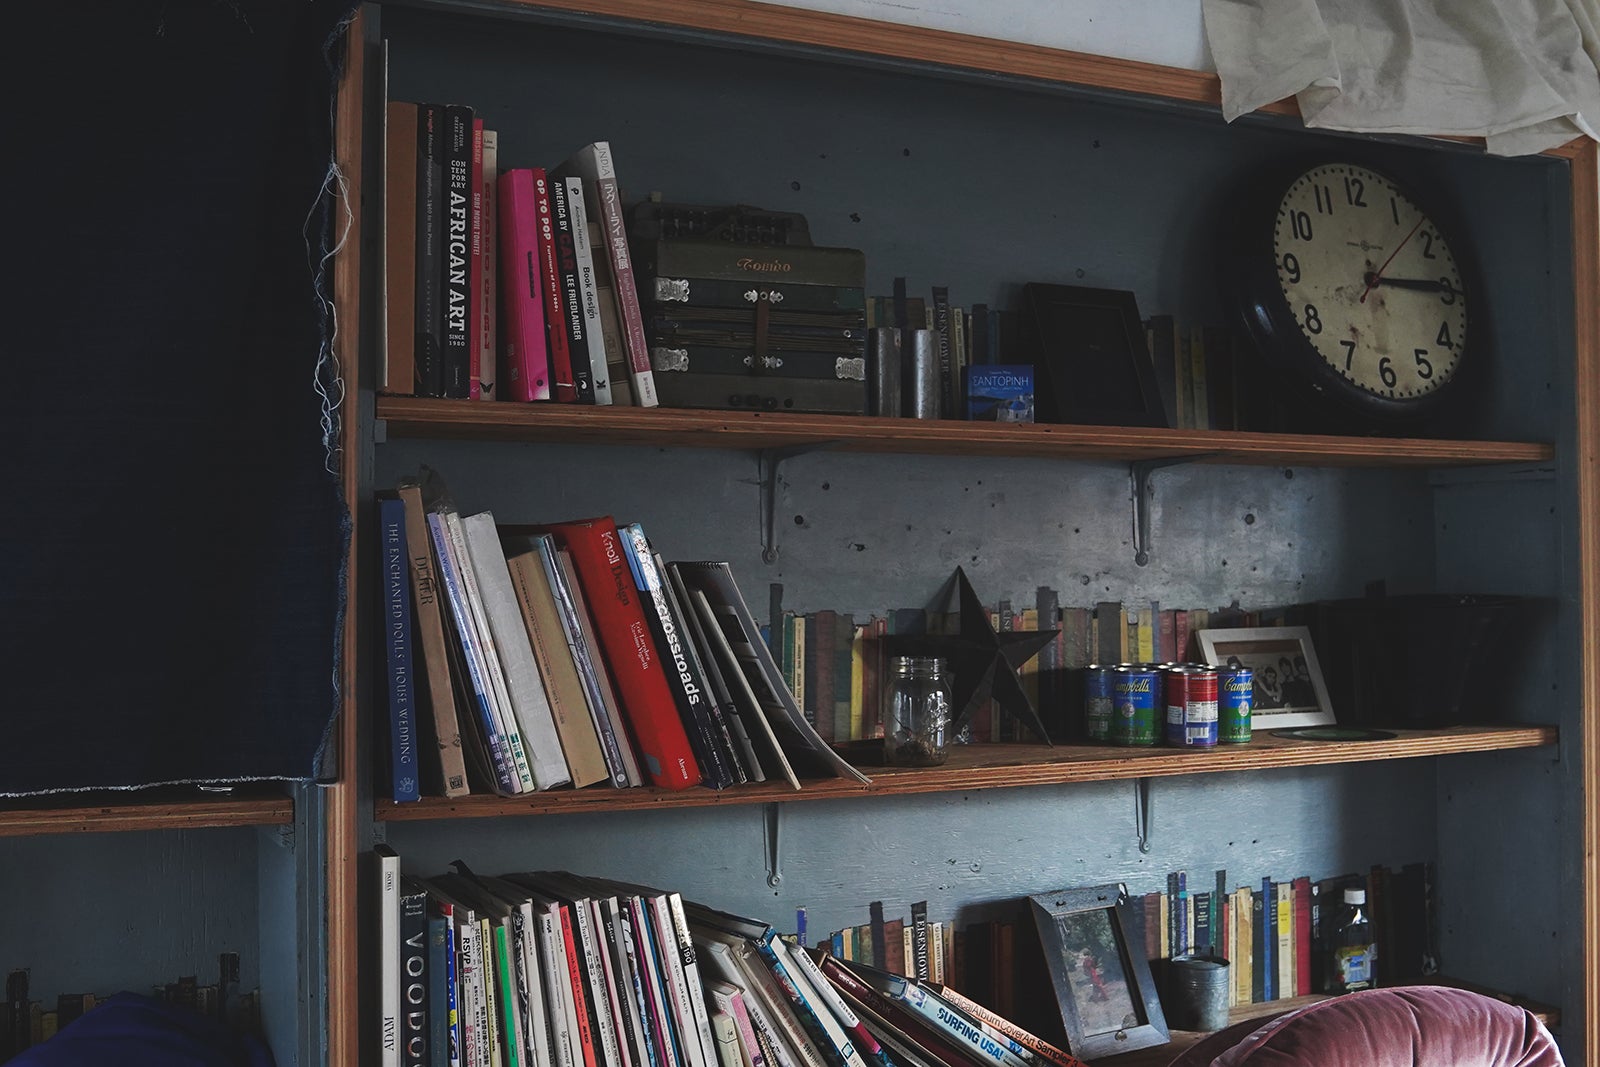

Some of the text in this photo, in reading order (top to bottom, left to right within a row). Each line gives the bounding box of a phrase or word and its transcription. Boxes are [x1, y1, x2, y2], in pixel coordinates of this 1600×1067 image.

[599, 147, 611, 177] INDIA
[472, 192, 480, 209] SURF
[536, 178, 545, 194] OP
[1314, 184, 1333, 215] 11
[1344, 177, 1367, 208] 12
[472, 210, 480, 230] MOVIE
[538, 198, 548, 213] TO
[1390, 197, 1400, 225] 1
[541, 216, 551, 241] POP
[1290, 210, 1313, 241] 10
[1419, 230, 1435, 259] 2
[449, 191, 465, 331] AFRICAN ART
[553, 181, 582, 340] AMERICA BY CAR LEE FRIEDLANDER
[1283, 253, 1301, 284] 9
[582, 267, 597, 320] Book design
[1439, 277, 1456, 306] 3
[1305, 304, 1323, 334] 8
[1436, 321, 1453, 350] 4
[1340, 340, 1356, 371] 7
[1414, 349, 1433, 379] 5
[1379, 357, 1397, 388] 6
[387, 522, 399, 543] THE
[388, 547, 403, 618] ENCHANTED
[601, 531, 630, 606] Knoll Design
[655, 604, 700, 706] crossroads
[394, 666, 408, 703] HOUSE
[397, 708, 411, 765] WEDDING
[462, 937, 471, 964] RSVP
[681, 946, 693, 964] 190
[404, 931, 426, 1067] VOODO
[384, 1016, 394, 1050] ADAM
[937, 1007, 980, 1043] SURFING
[979, 1038, 1005, 1060] USA!
[1036, 1040, 1071, 1067] Sampler
